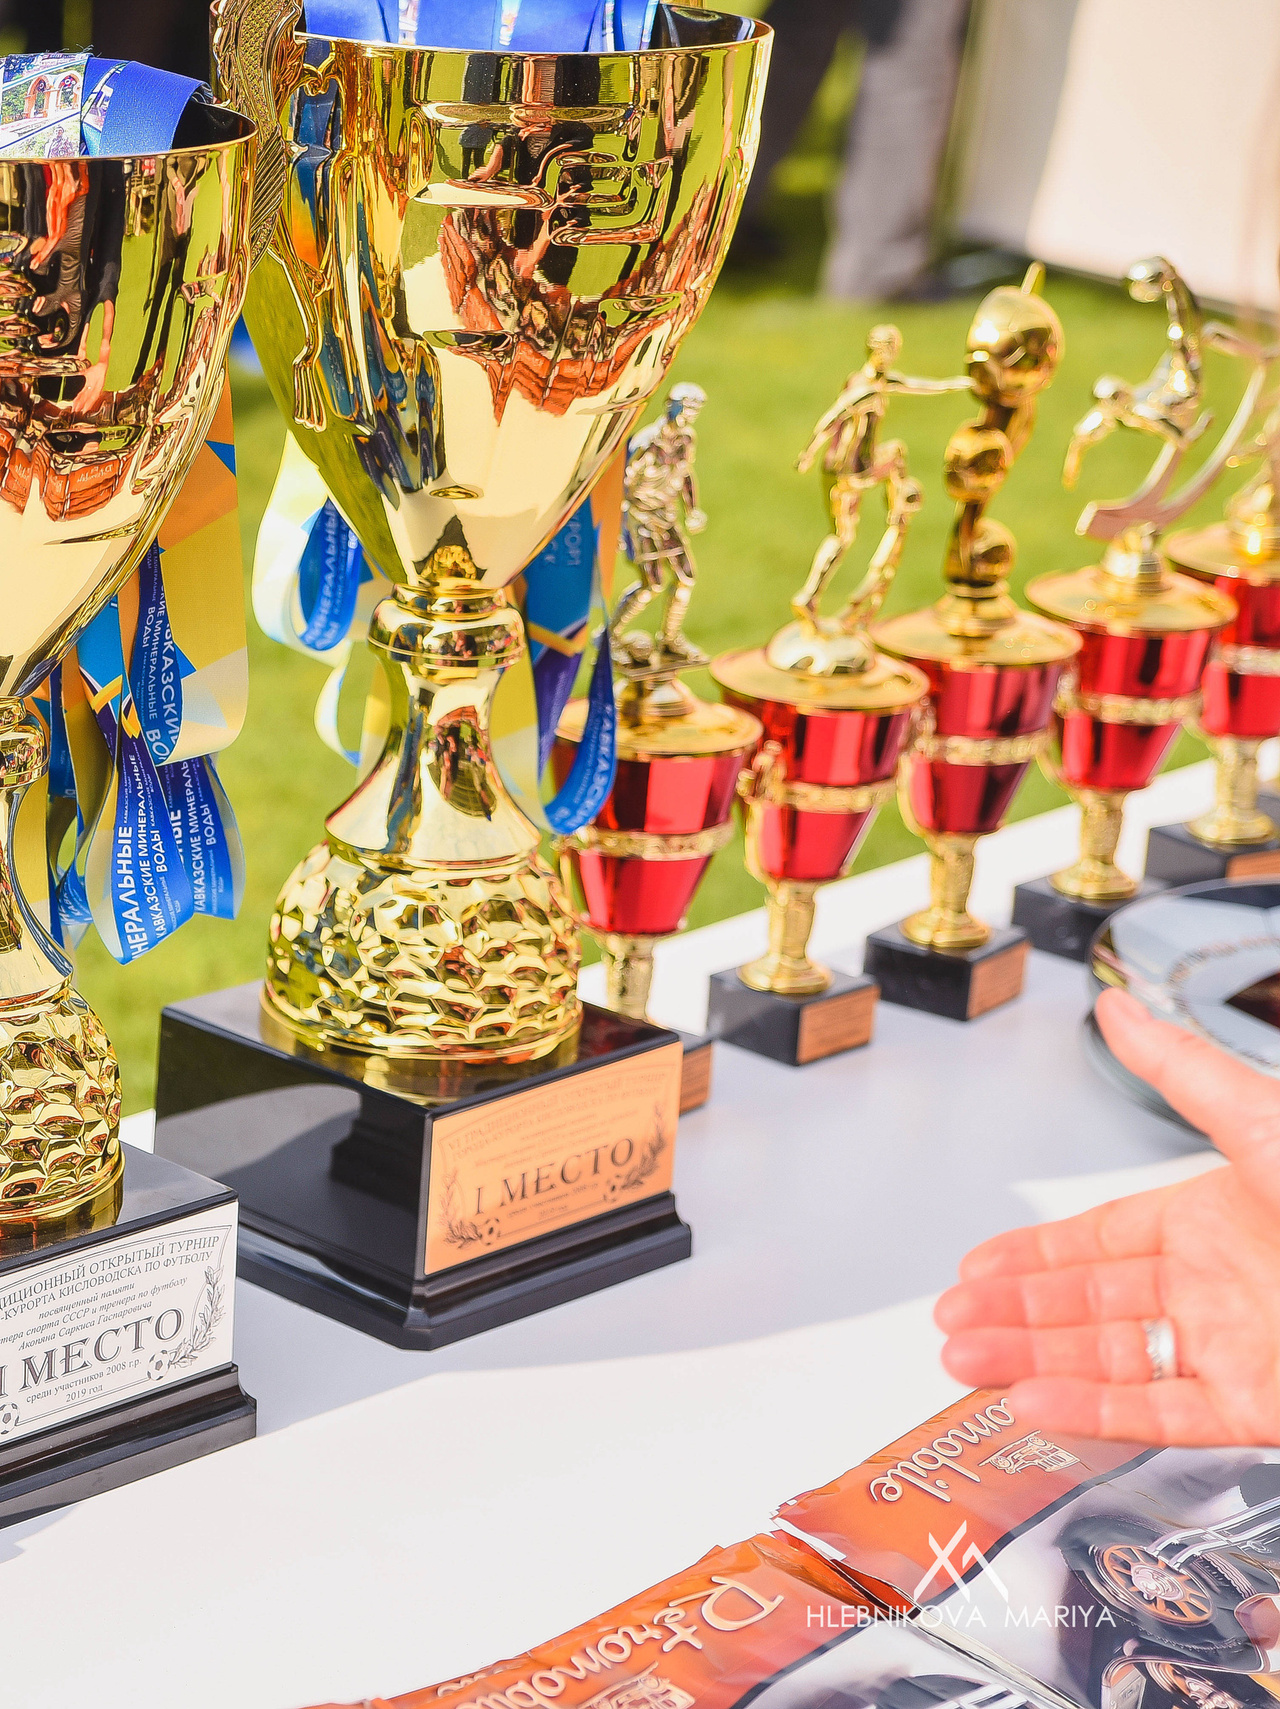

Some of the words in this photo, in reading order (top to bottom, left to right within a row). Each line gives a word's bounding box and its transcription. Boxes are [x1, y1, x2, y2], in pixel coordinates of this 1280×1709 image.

[142, 606, 156, 648] ВОДЫ
[148, 619, 163, 721] МИНЕРАЛЬНЫЕ
[146, 729, 171, 760] ВО
[129, 754, 149, 857] МИНЕРАЛЬНЫЕ
[200, 803, 216, 846] ВОДЫ
[150, 830, 168, 873] ВОДЫ
[475, 1186, 484, 1216] I
[500, 1138, 634, 1207] МЕСТО
[59, 1265, 141, 1298] КИСЛОВОДСКА
[144, 1261, 160, 1272] ПО
[163, 1251, 213, 1267] ФУТБОЛУ
[89, 1242, 165, 1275] ОТКРЫТЫЙ
[168, 1236, 219, 1253] ТУРНИР
[26, 1320, 59, 1336] спорта
[62, 1308, 90, 1323] СССР
[99, 1294, 136, 1312] тренера
[138, 1290, 149, 1299] по
[150, 1277, 188, 1297] футболу
[39, 1293, 98, 1319] посвященный
[100, 1283, 135, 1299] памяти
[19, 1333, 56, 1351] Акопяна
[58, 1320, 95, 1338] Саркиса
[97, 1300, 152, 1325] Гаспаровича
[19, 1308, 185, 1392] МЕСТО
[26, 1388, 53, 1404] среди
[54, 1371, 104, 1396] участников
[105, 1361, 127, 1376] 2008
[65, 1389, 87, 1403] 2019
[88, 1384, 103, 1397] год
